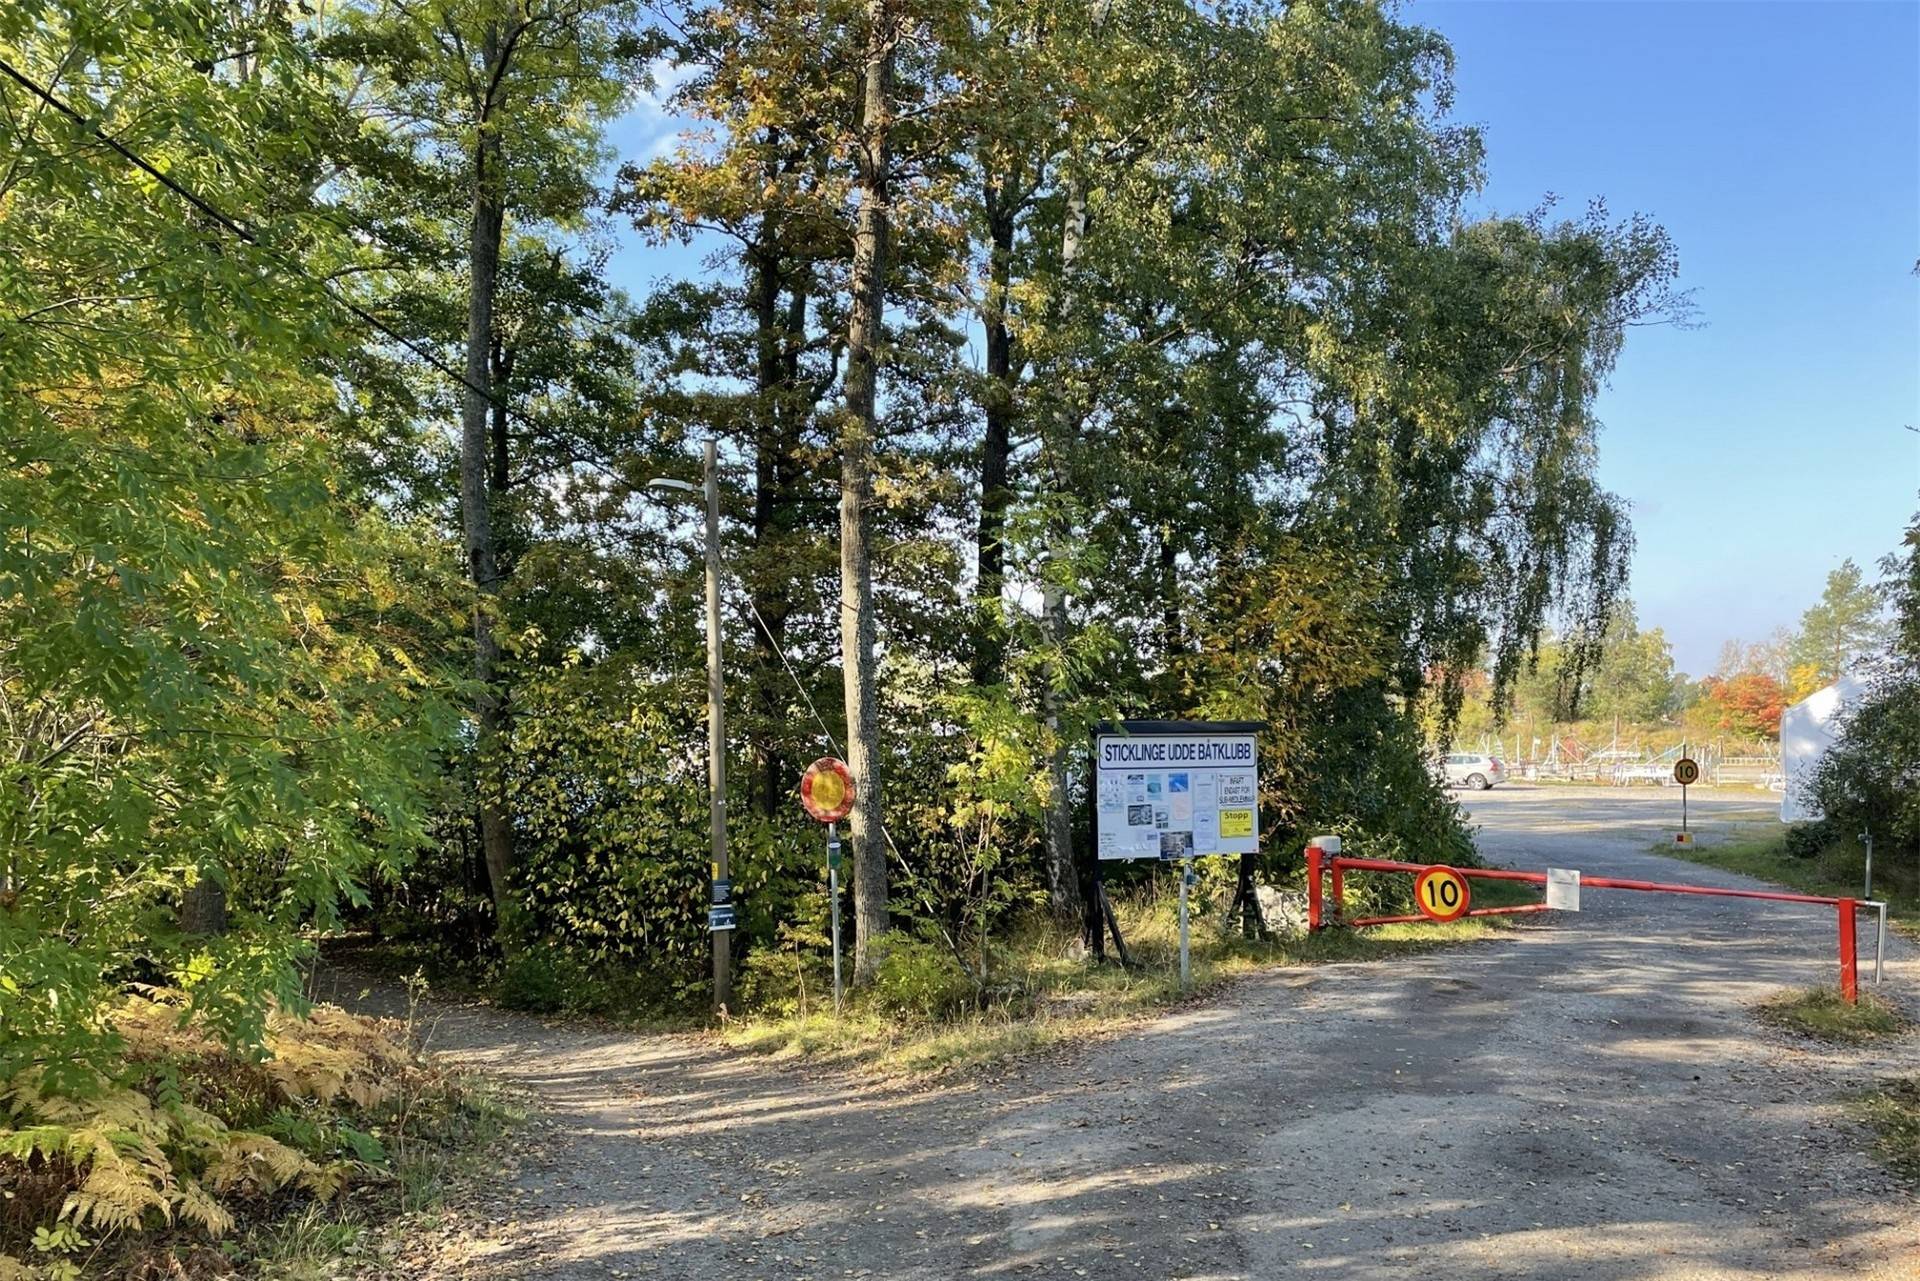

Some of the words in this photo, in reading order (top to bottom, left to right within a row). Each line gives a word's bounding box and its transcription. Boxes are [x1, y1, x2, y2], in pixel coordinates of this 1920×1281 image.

[1105, 743, 1166, 762] STICKLINGE
[1168, 743, 1196, 760] UDDE
[1198, 739, 1251, 760] BÅTKLUBB
[1680, 766, 1694, 778] 10
[1224, 812, 1249, 820] Stopp
[1427, 879, 1459, 907] 10
